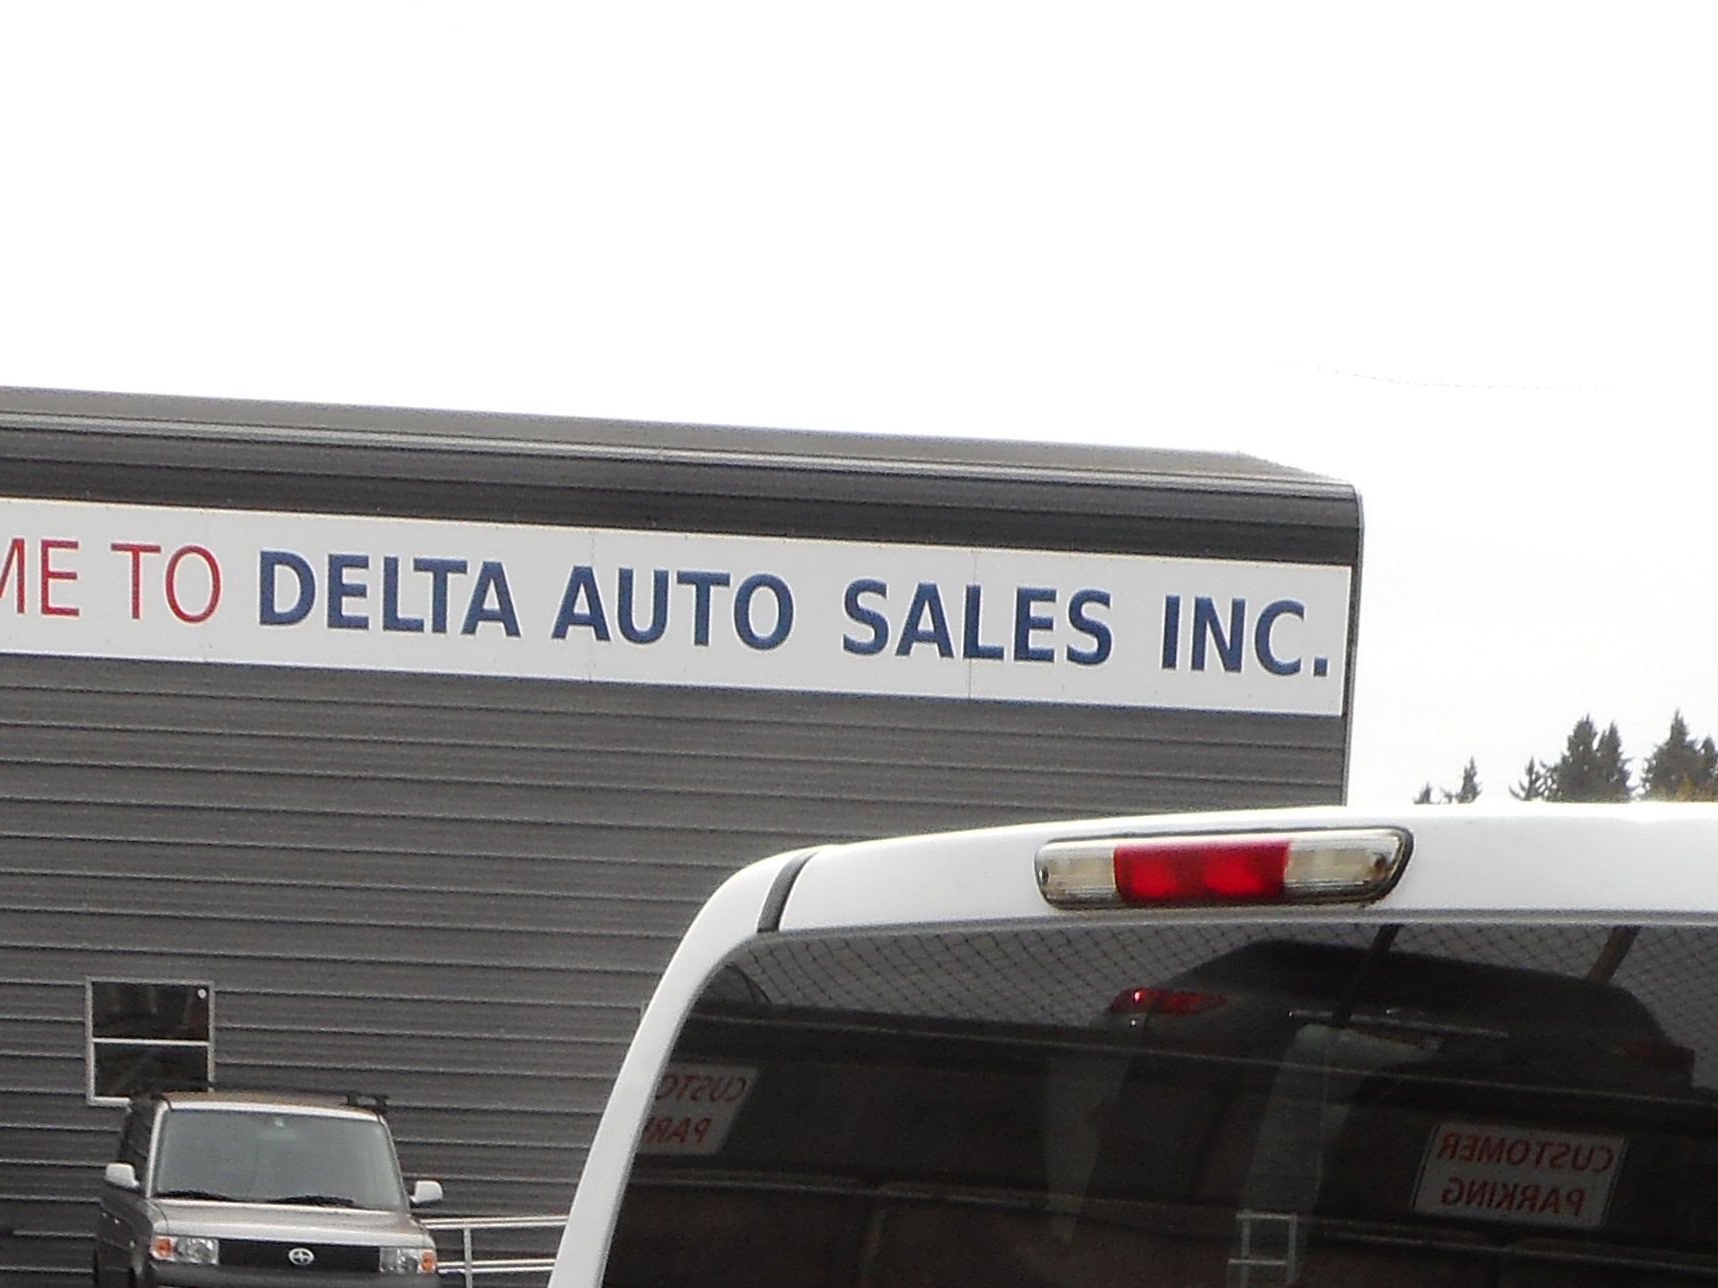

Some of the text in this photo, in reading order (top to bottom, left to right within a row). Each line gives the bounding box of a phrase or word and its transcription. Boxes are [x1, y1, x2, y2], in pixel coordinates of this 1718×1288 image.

[110, 543, 221, 624] TO
[259, 550, 521, 638] DELTA
[551, 565, 794, 651] AUTO
[843, 579, 1112, 666] SALES
[1161, 595, 1328, 677] INC.
